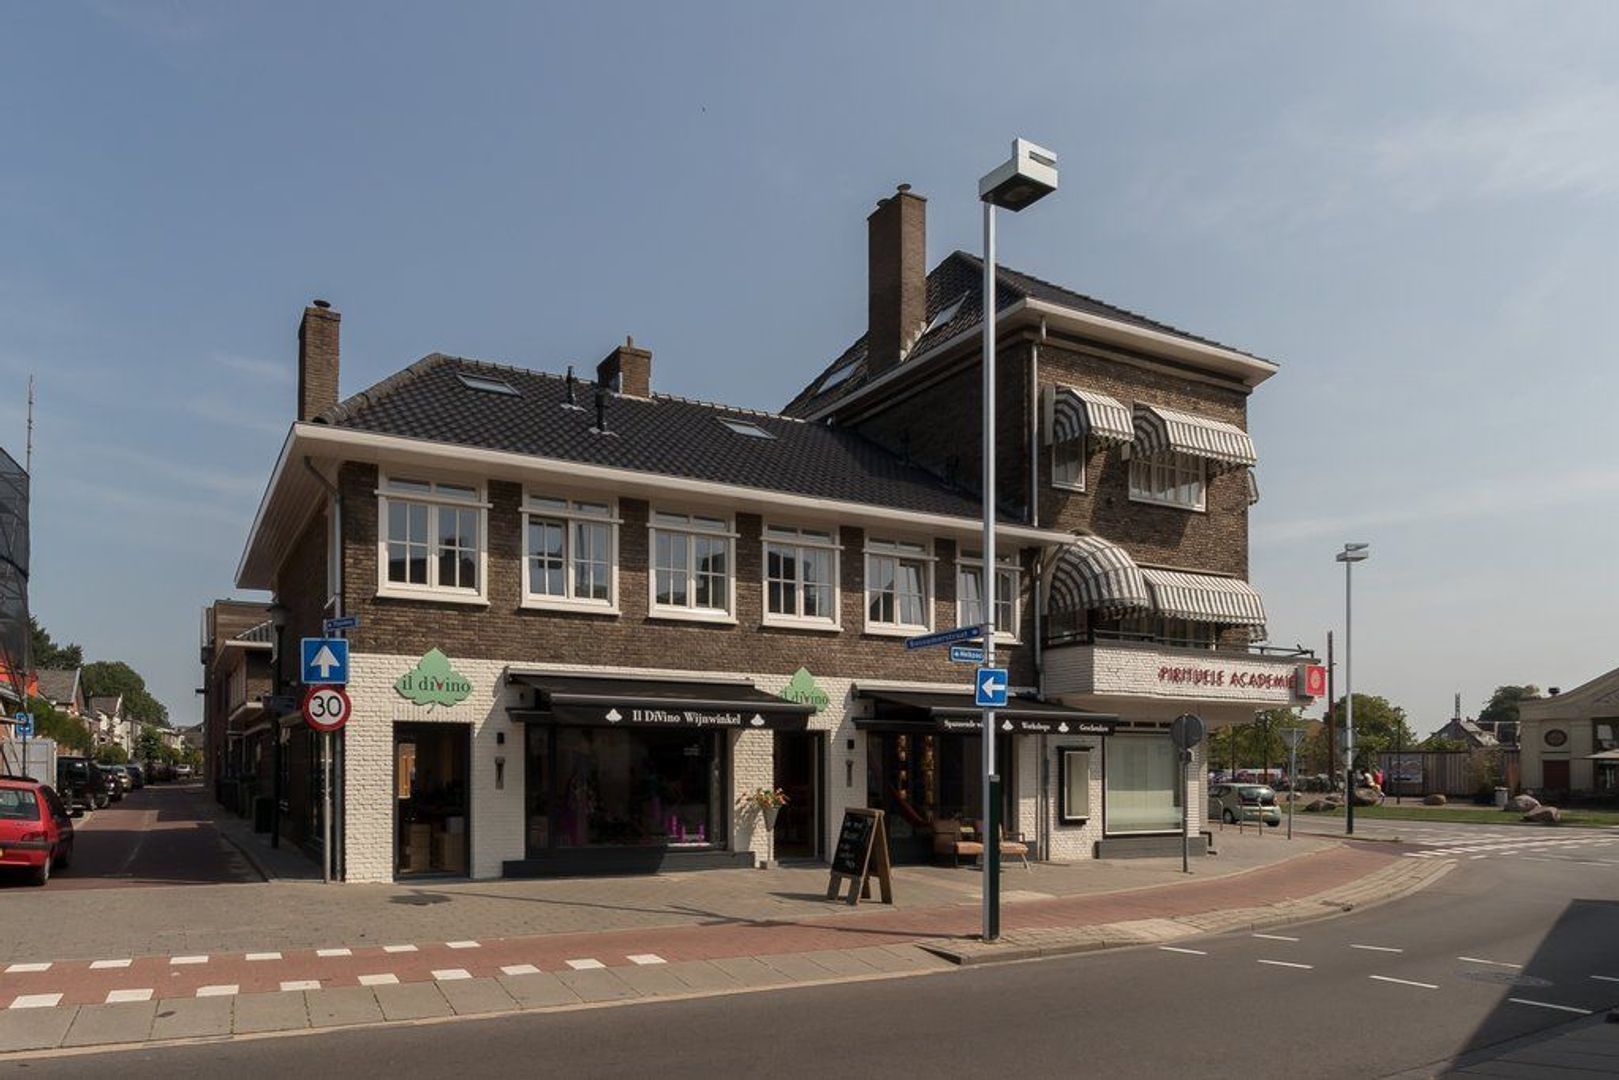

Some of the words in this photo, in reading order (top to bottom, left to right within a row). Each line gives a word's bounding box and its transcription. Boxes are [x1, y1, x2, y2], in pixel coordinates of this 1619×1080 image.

[403, 675, 413, 691] il
[1229, 671, 1297, 690] ACADEMIE
[312, 695, 342, 717] 30
[684, 711, 741, 727] Wijnwinkel
